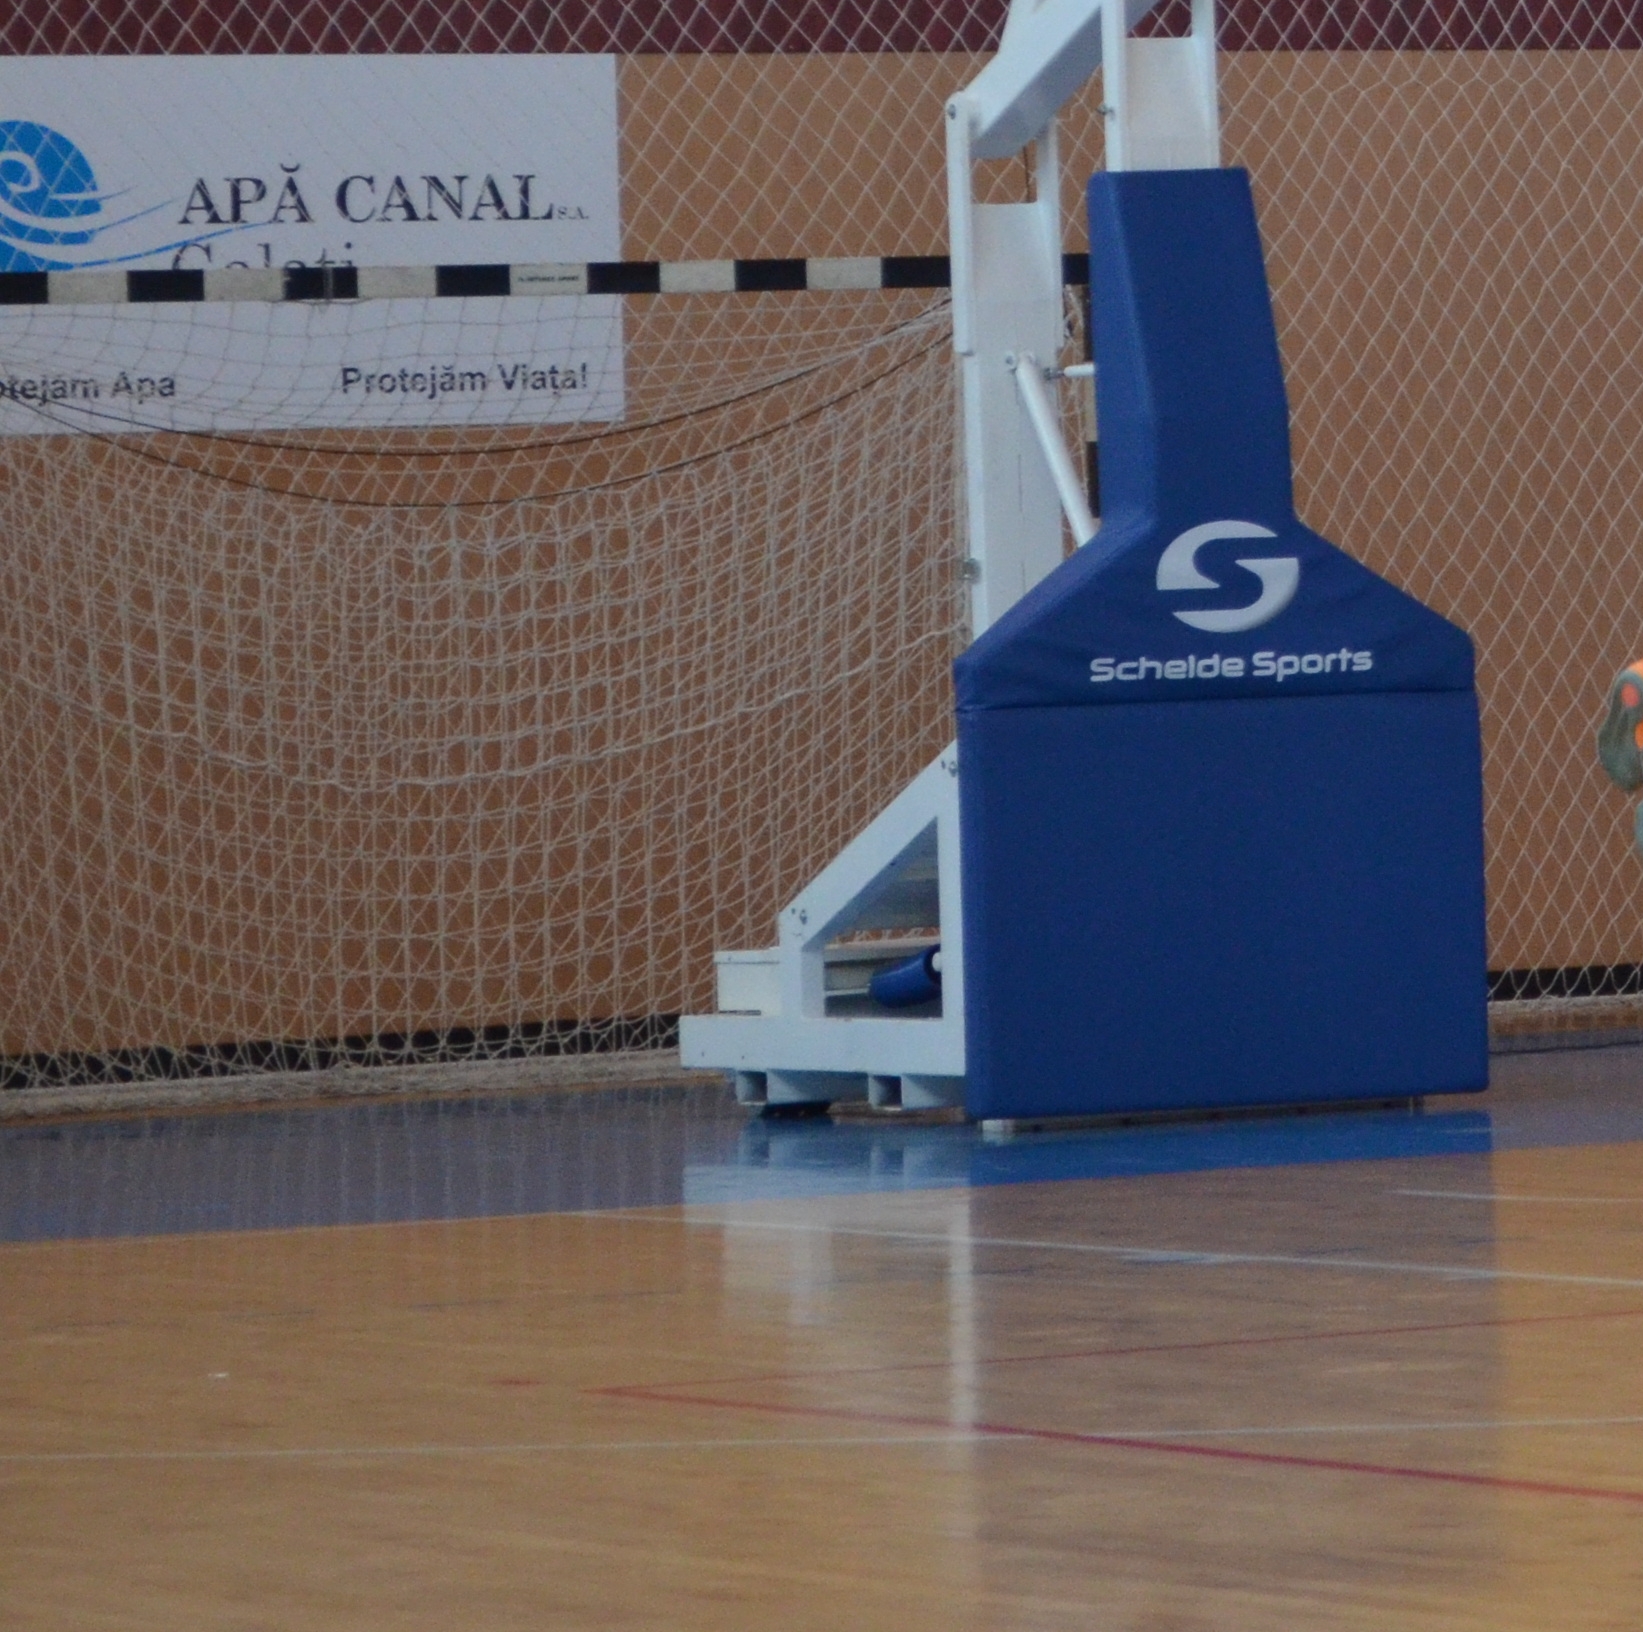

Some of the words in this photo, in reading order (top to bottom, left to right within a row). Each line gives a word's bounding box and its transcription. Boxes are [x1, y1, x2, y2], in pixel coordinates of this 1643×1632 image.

[178, 163, 315, 223] APĂ
[335, 174, 553, 223] CANAL
[341, 365, 488, 400] Protejăm
[1090, 653, 1245, 682] Schelde
[1252, 647, 1374, 682] Sports
